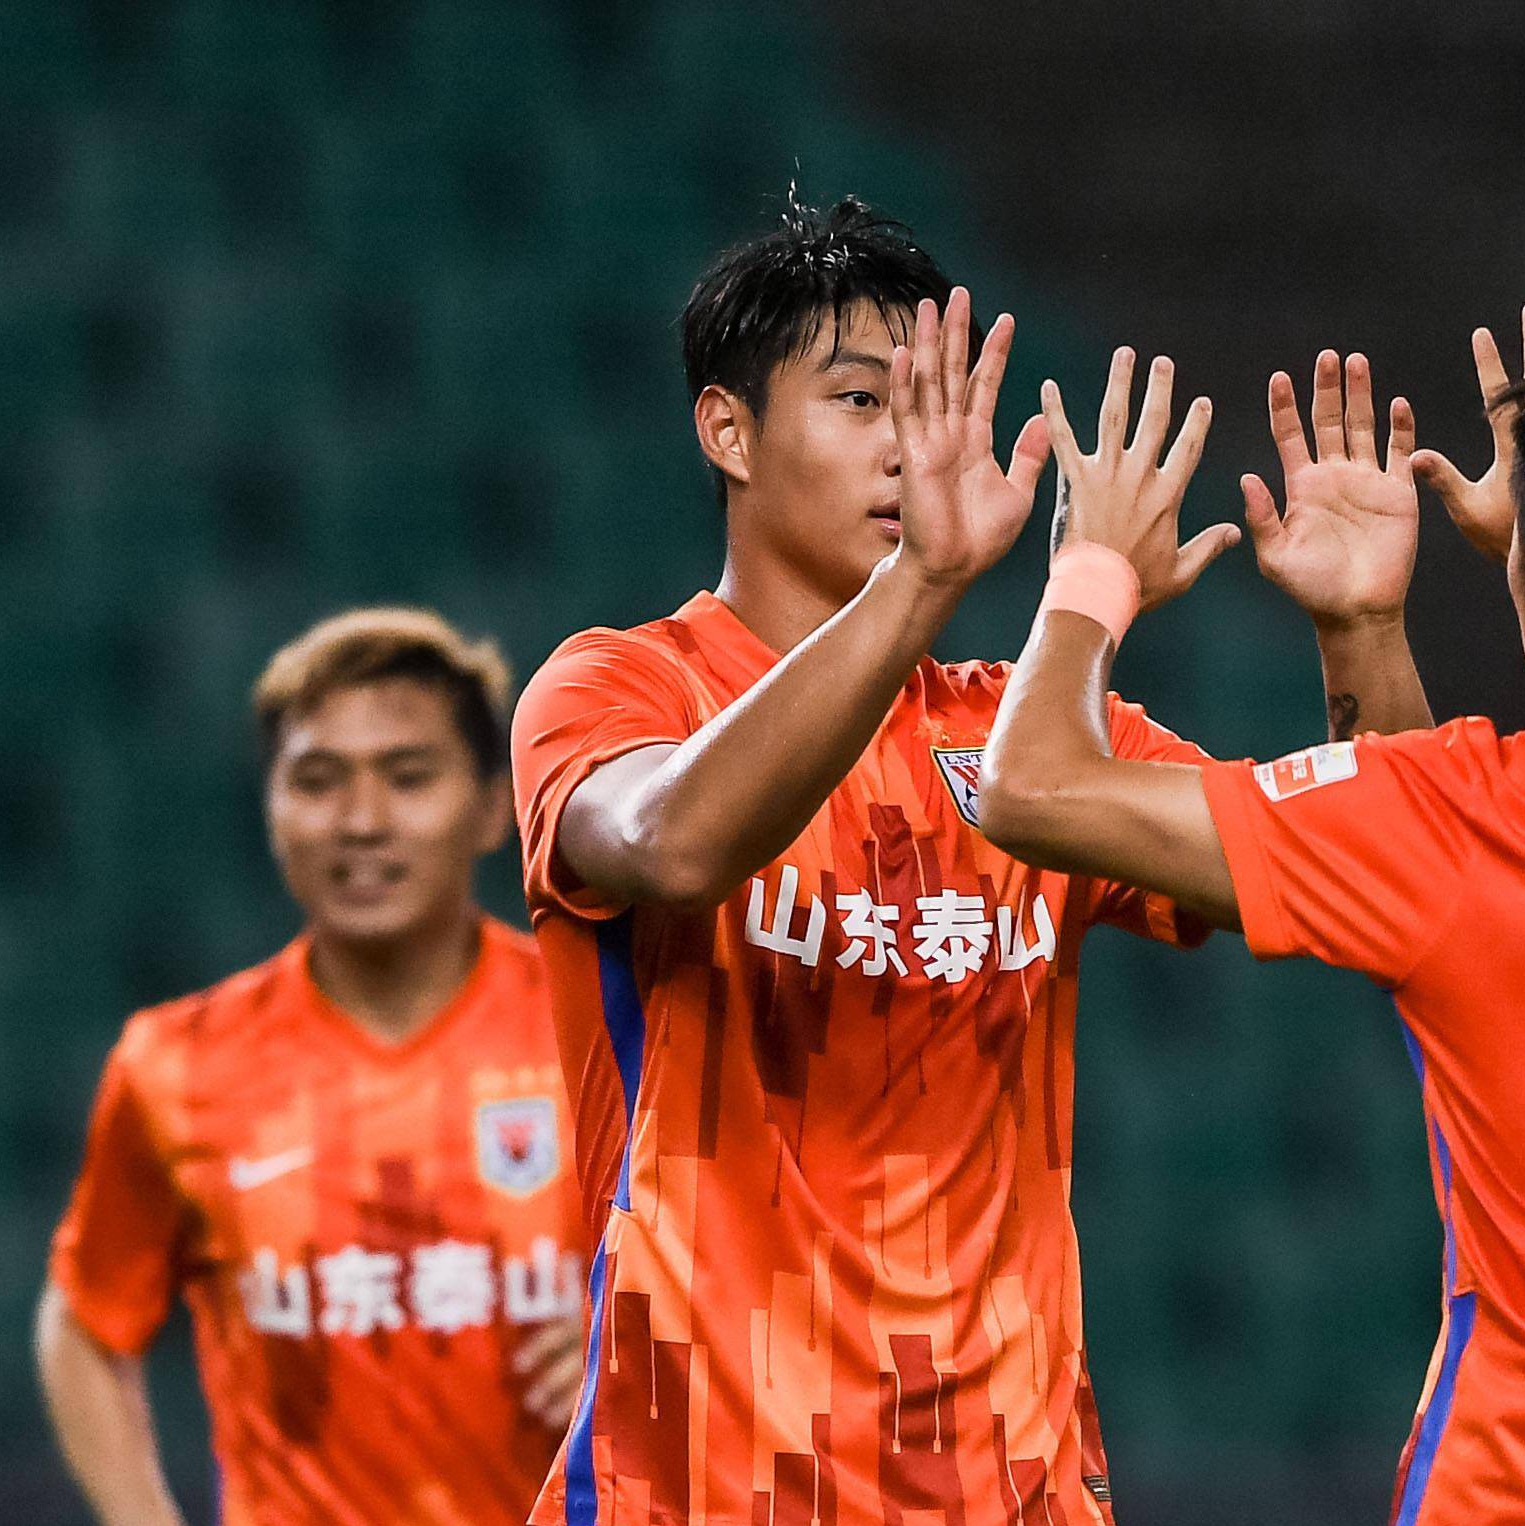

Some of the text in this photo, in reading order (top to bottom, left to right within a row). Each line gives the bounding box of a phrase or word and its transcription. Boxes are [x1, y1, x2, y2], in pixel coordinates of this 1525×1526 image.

[744, 863, 1056, 983] 山东泰山
[238, 1235, 584, 1338] 山东泰山
